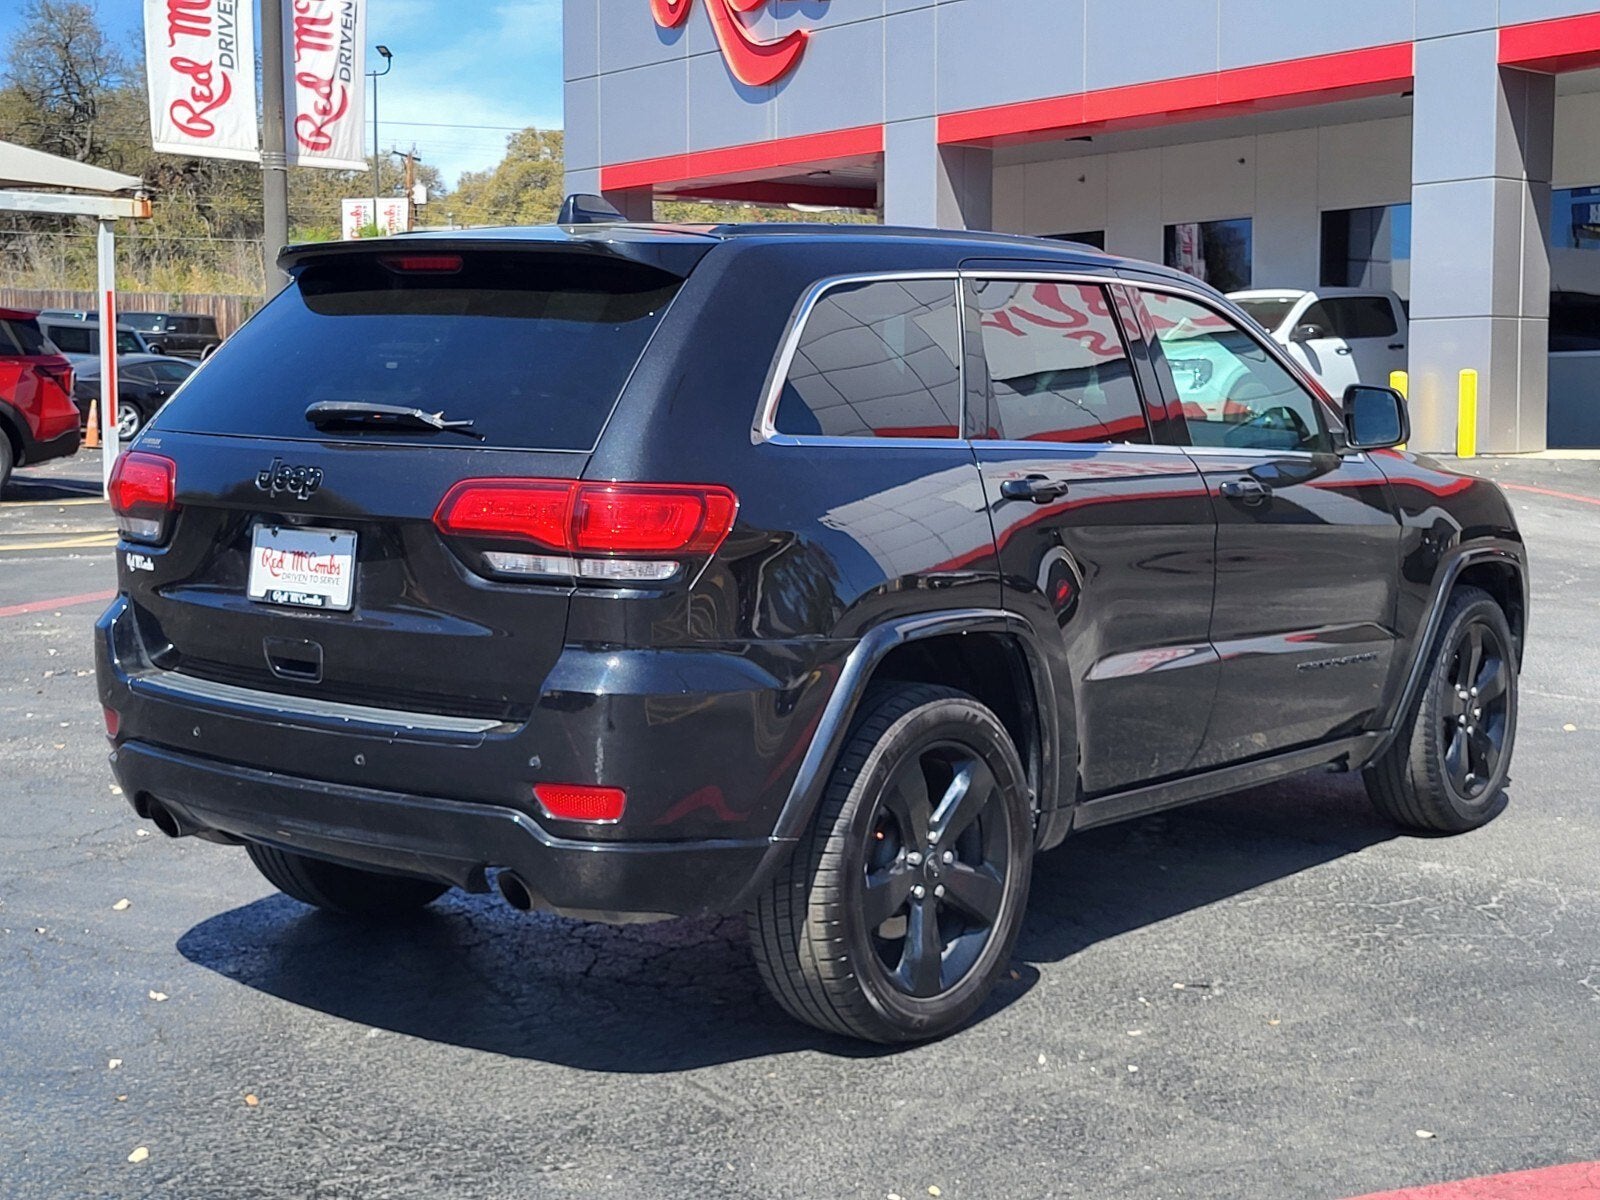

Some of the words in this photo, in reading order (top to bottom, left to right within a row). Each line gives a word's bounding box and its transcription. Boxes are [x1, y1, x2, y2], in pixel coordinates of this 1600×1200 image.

[217, 0, 235, 70] DRIVE
[339, 1, 353, 82] DRIVEN
[169, 56, 232, 139] Red
[294, 72, 348, 152] Red
[254, 456, 324, 500] Jeep
[262, 547, 286, 577] Red
[290, 550, 341, 576] McCombs
[281, 572, 308, 583] DRIVEN
[310, 575, 319, 584] TO
[320, 576, 341, 586] SERVE
